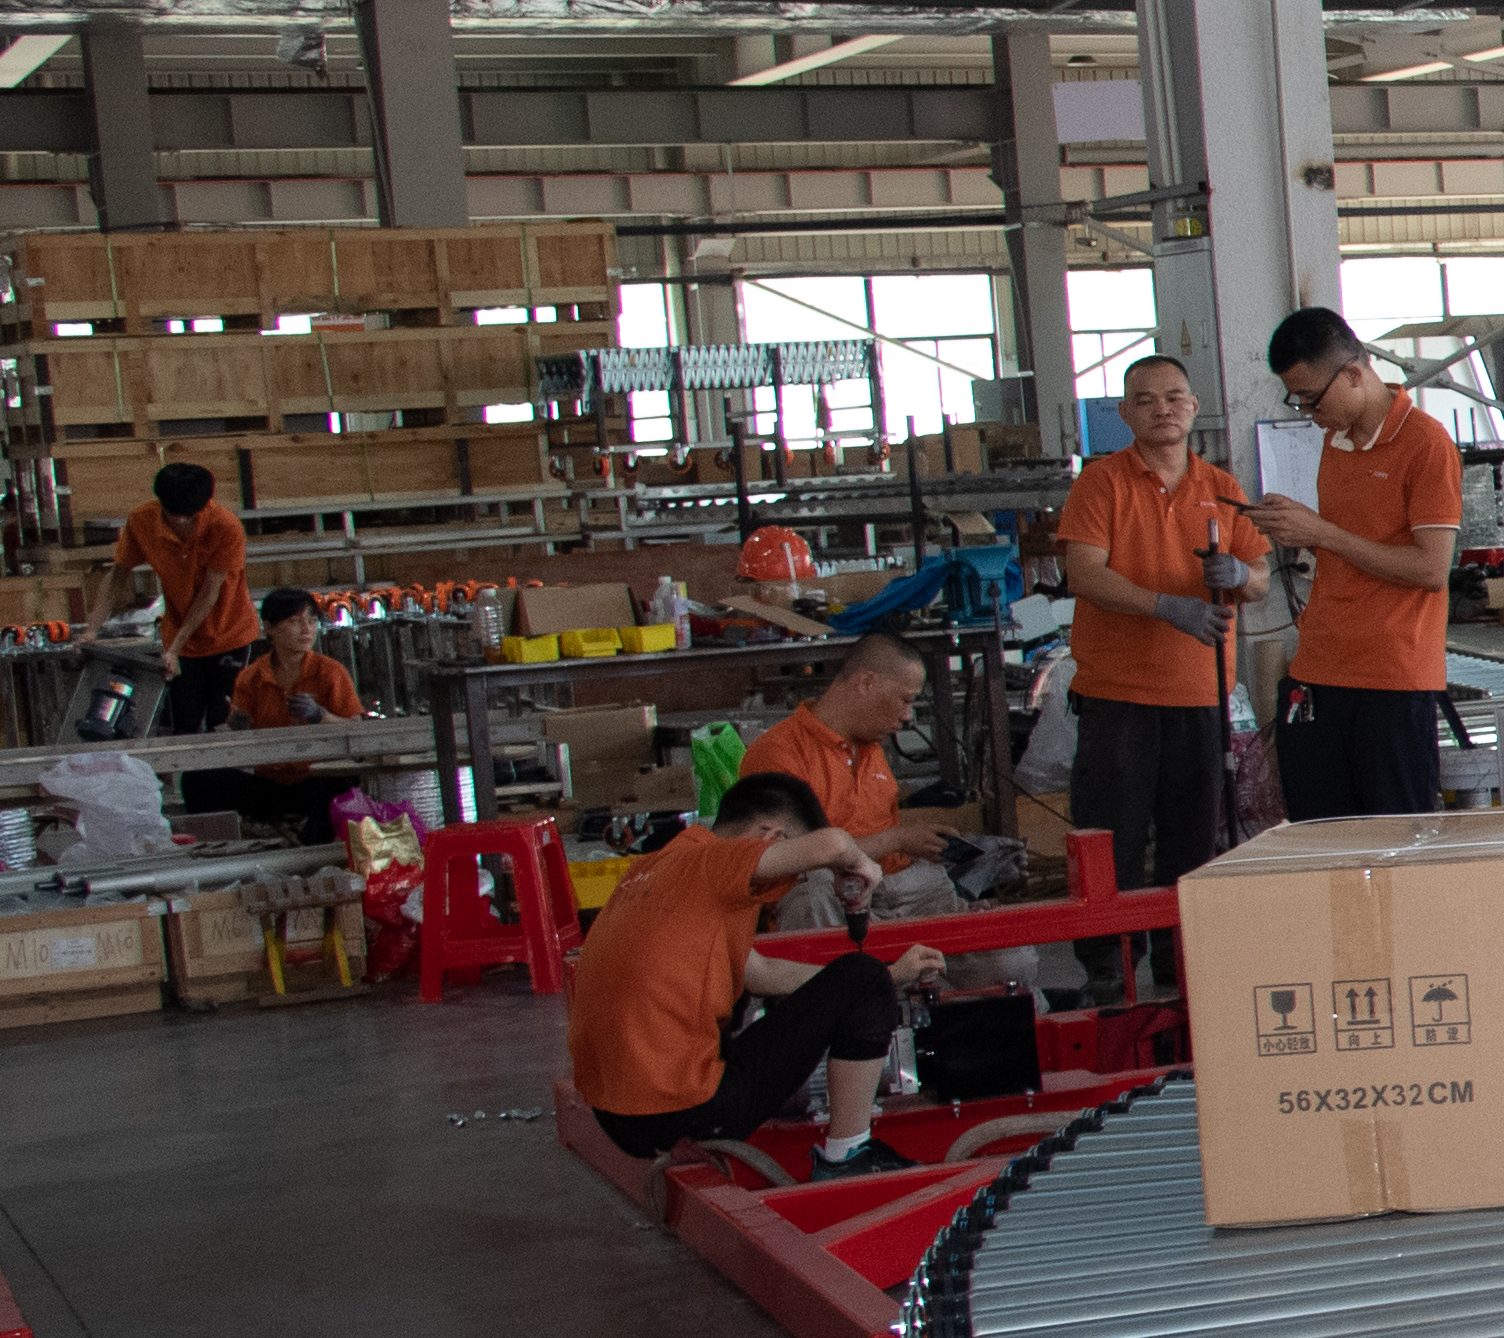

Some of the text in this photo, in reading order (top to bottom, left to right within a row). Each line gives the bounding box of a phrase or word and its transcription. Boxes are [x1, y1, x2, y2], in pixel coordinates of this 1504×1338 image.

[1263, 1035, 1311, 1053] 小心轻放
[1348, 1031, 1383, 1048] 向上
[1278, 1080, 1475, 1114] 56X32X32CM
